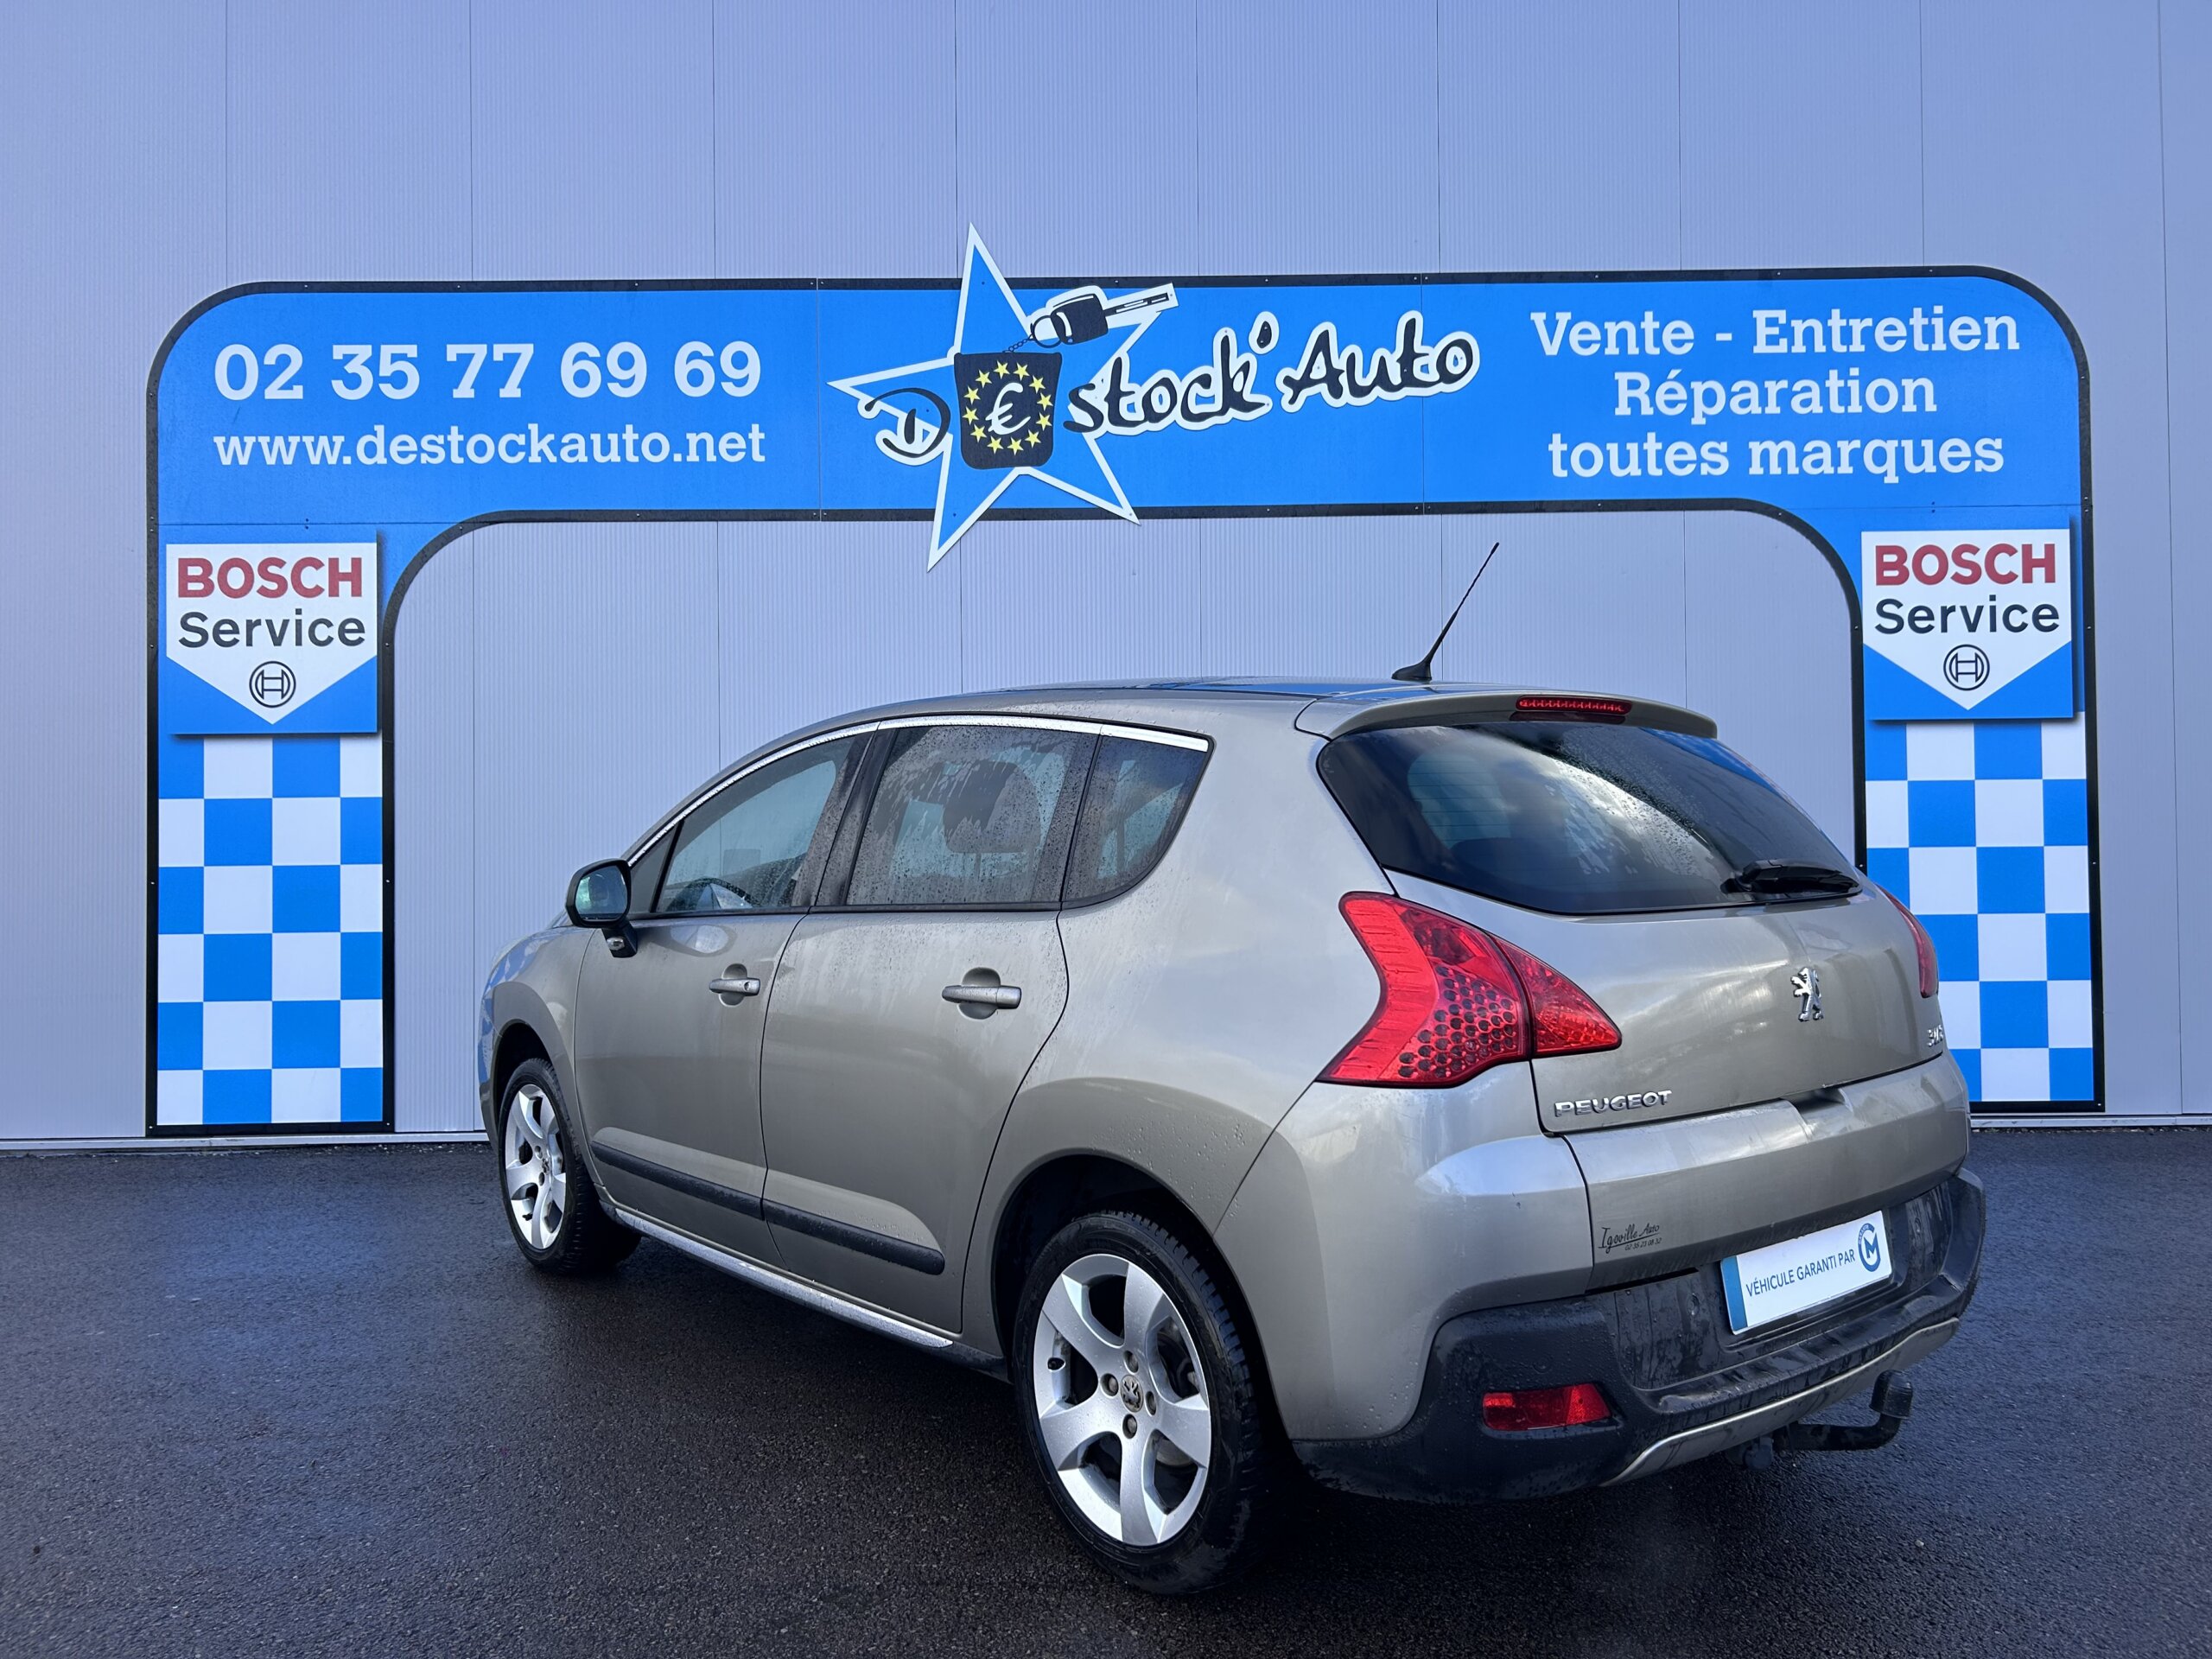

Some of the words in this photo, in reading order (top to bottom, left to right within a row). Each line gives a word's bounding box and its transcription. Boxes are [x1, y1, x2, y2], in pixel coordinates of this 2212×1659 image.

[1531, 312, 1694, 356] Vente
[1716, 333, 1732, 341] -
[1752, 306, 2020, 353] Entretien
[215, 343, 304, 400] 02
[331, 344, 420, 400] 35
[446, 343, 534, 398] 77
[560, 341, 647, 398] 69
[674, 340, 761, 397] 69
[1614, 368, 1937, 425] Réparation
[213, 423, 766, 466] www.destockauto.net
[1548, 432, 1729, 477] toutes
[1749, 438, 2005, 484] marques
[178, 557, 362, 598] BOSCH
[1876, 543, 2056, 585] BOSCH
[179, 608, 365, 648] Service
[1875, 594, 2060, 634] Service
[1554, 1090, 1673, 1117] PEUGEOT
[1598, 1224, 1638, 1254] Igoville
[1745, 1269, 1795, 1297] VÉHICULE
[1796, 1255, 1837, 1281] GARANTI
[1838, 1249, 1856, 1267] PAR
